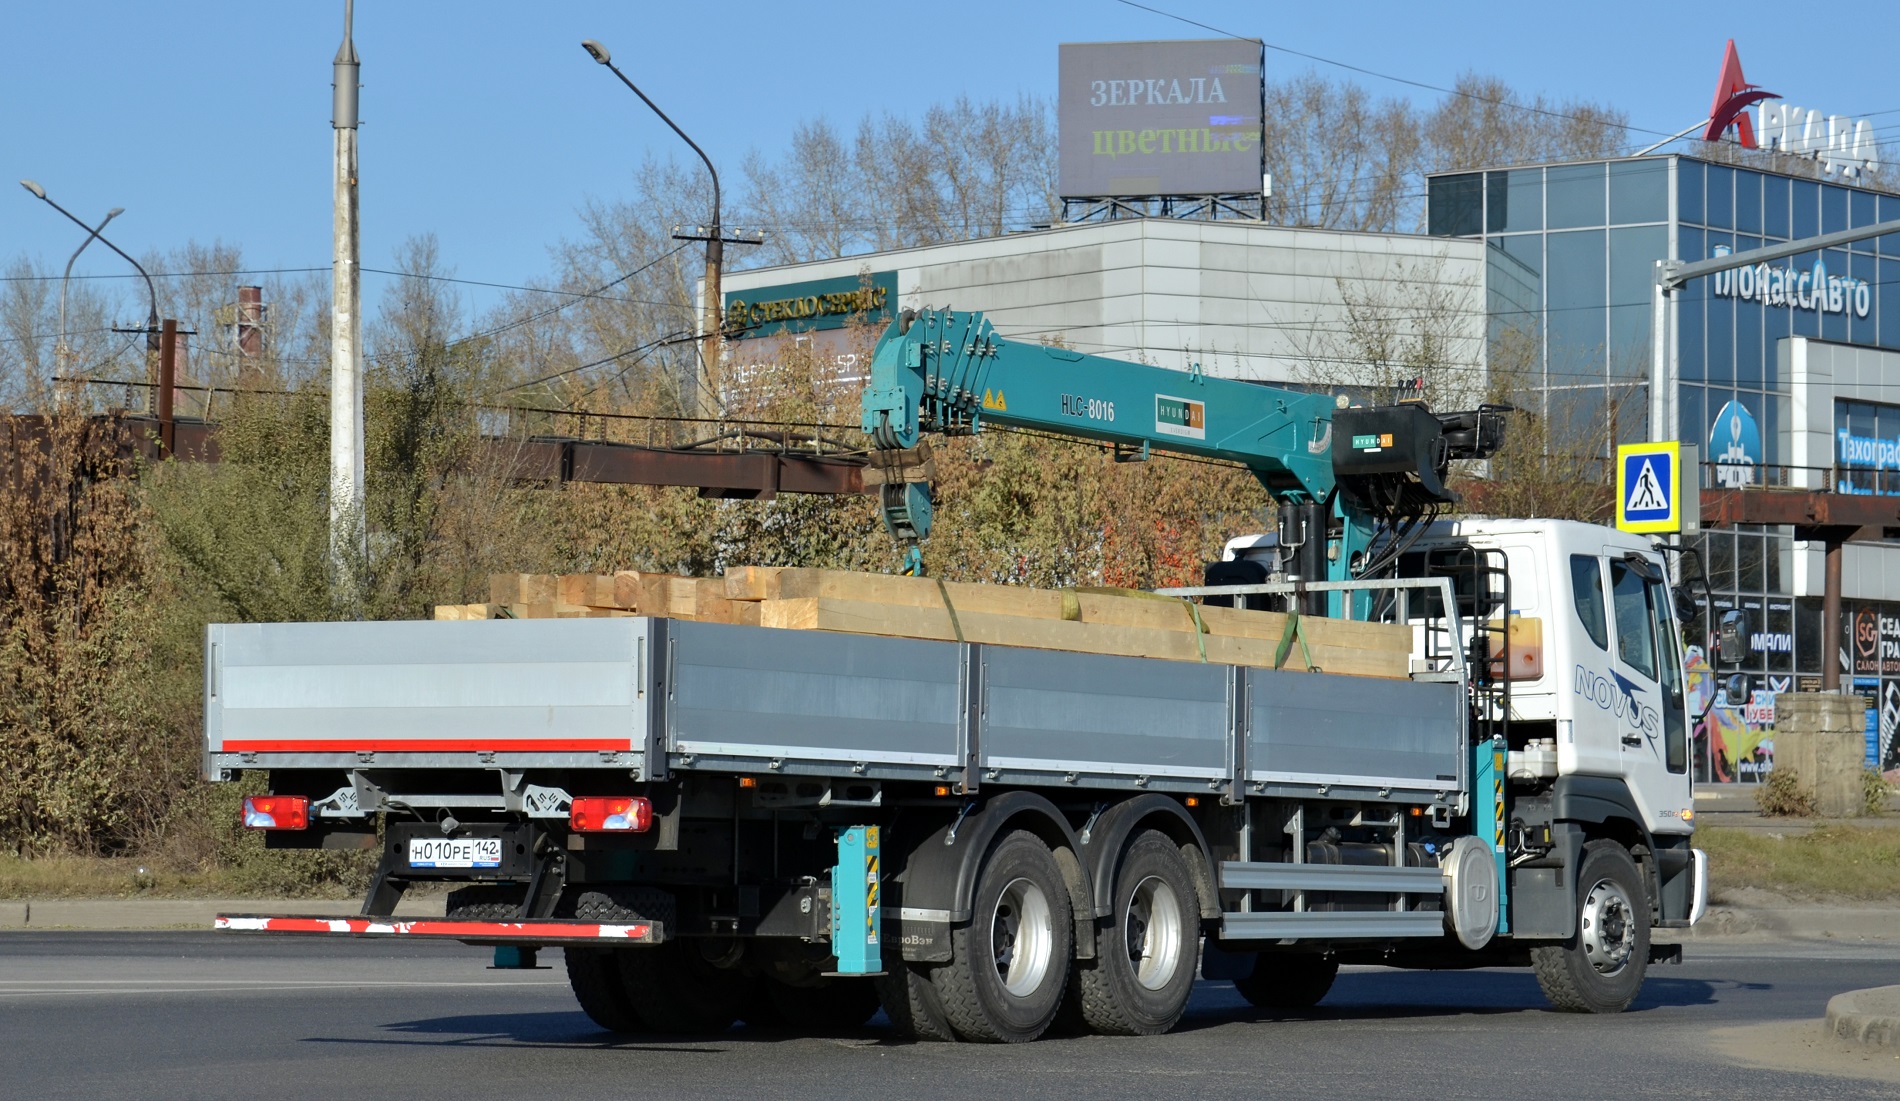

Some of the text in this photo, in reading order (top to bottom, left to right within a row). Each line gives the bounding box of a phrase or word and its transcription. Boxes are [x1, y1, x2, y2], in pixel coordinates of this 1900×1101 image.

[1090, 77, 1227, 107] ЗЕРКАЛА
[1703, 38, 1878, 177] АРКАДА
[1060, 394, 1115, 422] HLC-8016
[1160, 405, 1201, 422] HYUNDAI
[1355, 437, 1391, 445] HYUNDAI
[1856, 660, 1879, 671] САЛОН
[1575, 664, 1659, 739] NOVUS
[475, 841, 497, 855] 142
